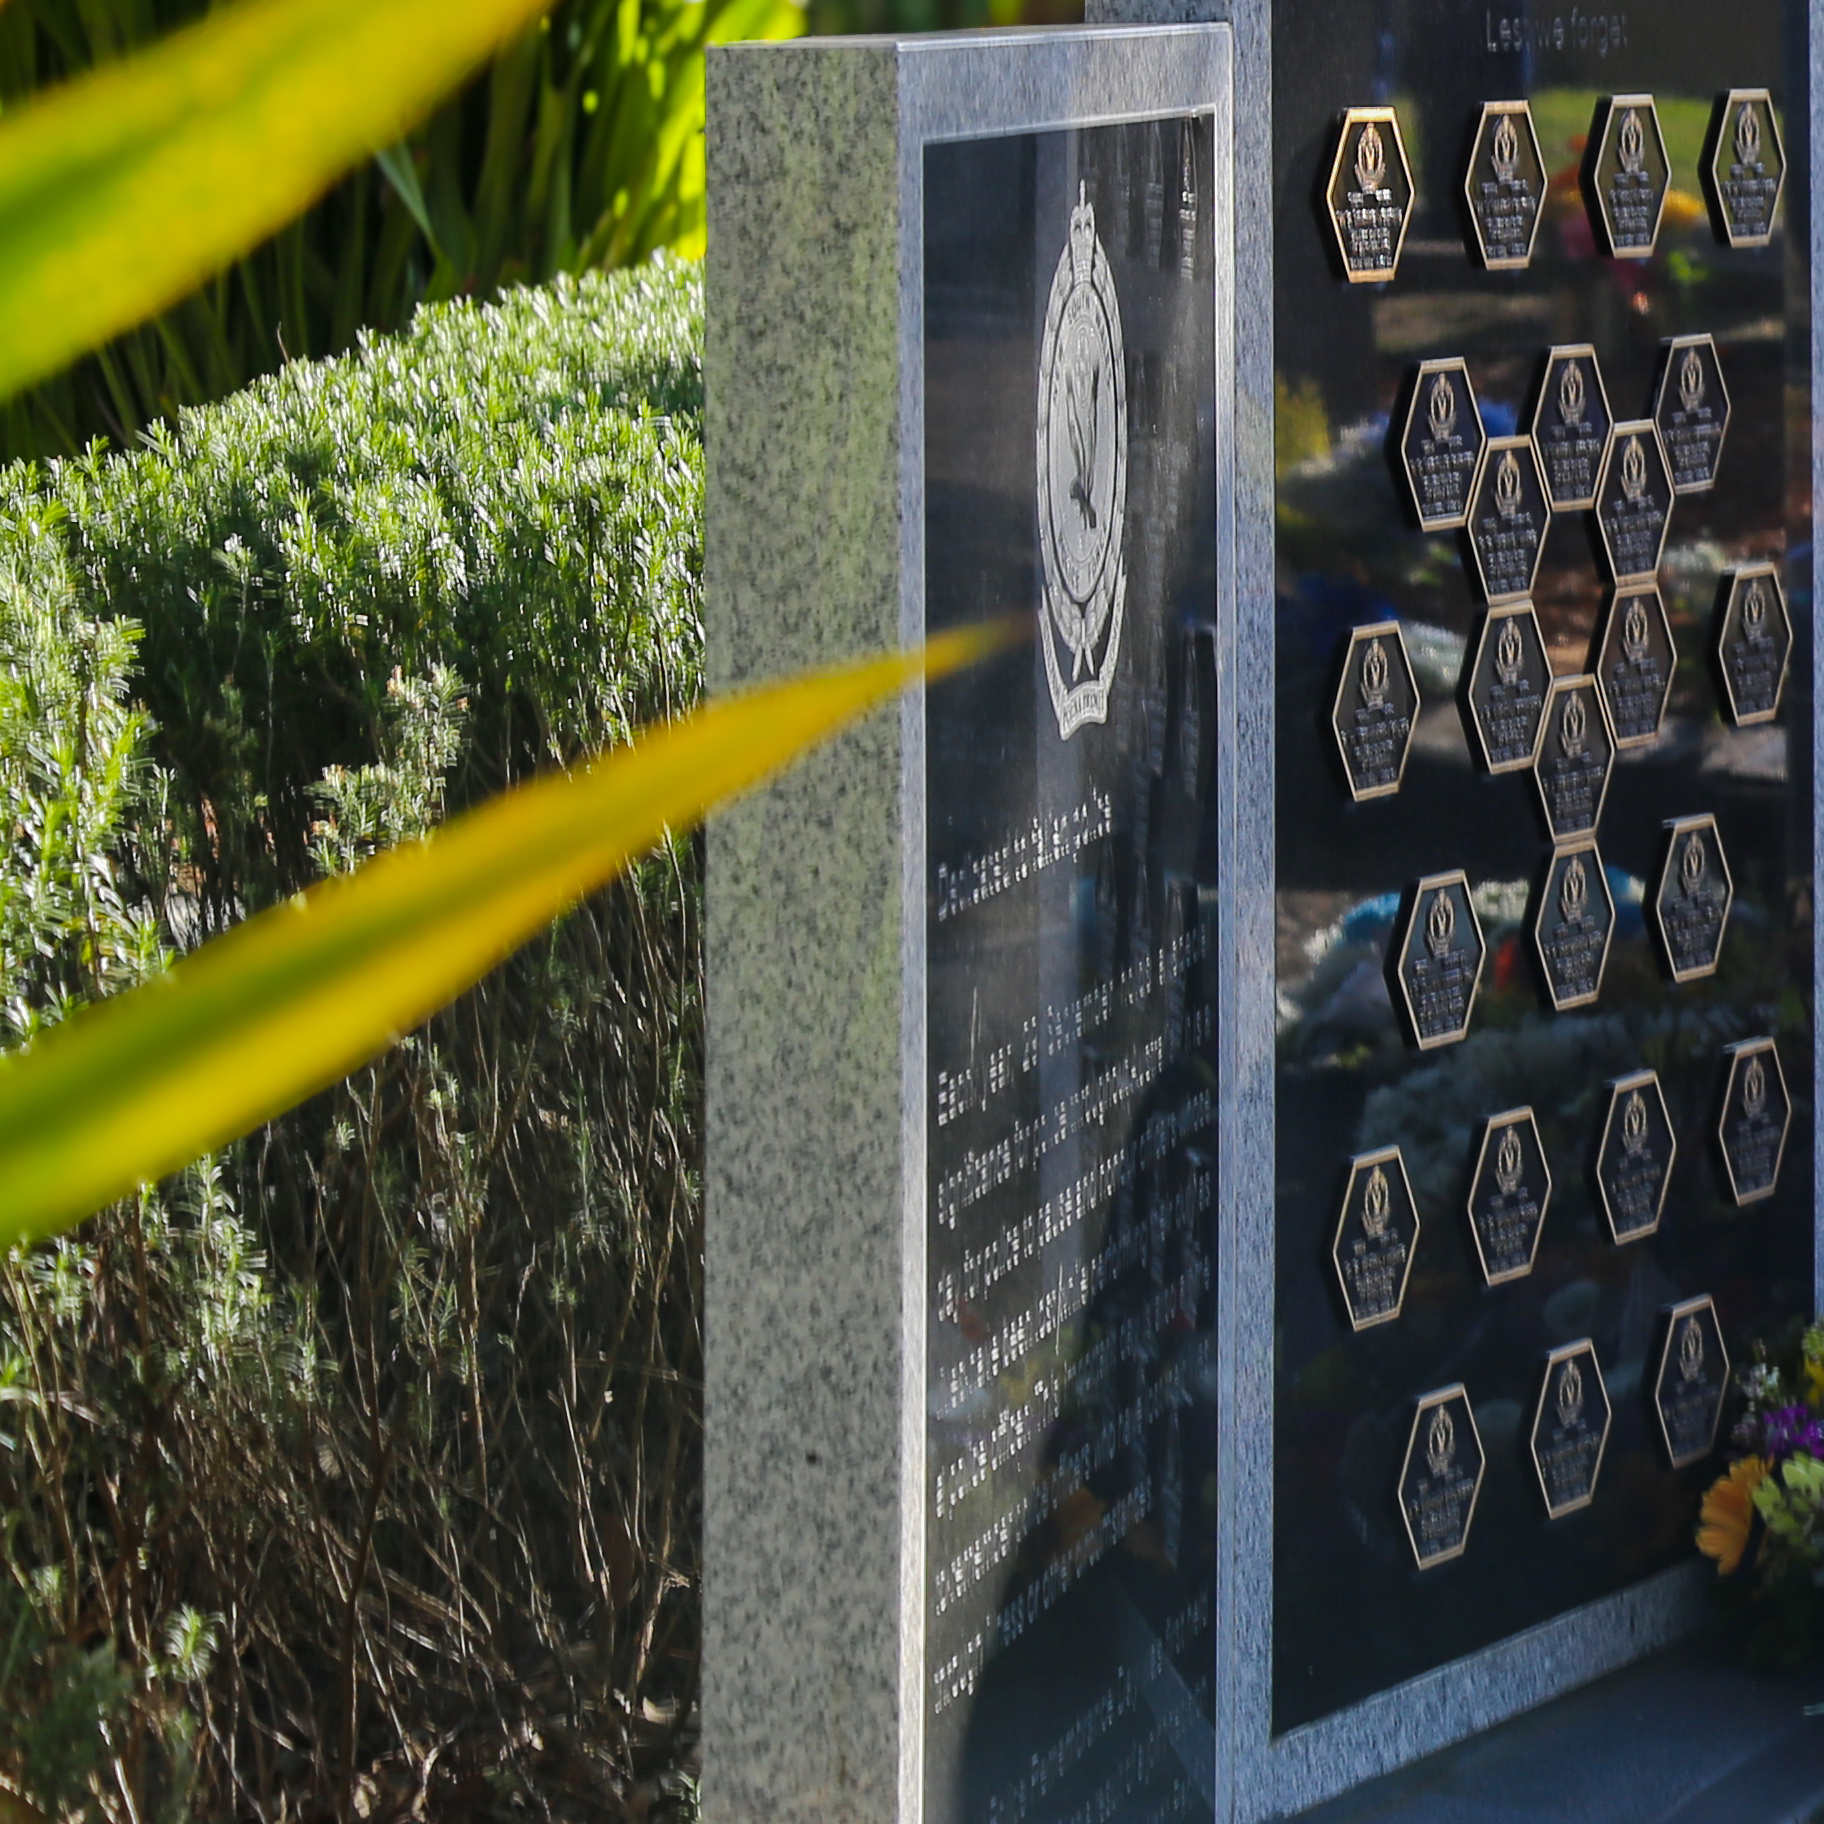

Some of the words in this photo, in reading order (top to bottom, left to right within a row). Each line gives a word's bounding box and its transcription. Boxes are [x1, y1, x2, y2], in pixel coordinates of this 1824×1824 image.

[938, 1054, 972, 1127] Each
[976, 1041, 1012, 1114] year
[1046, 977, 1113, 1059] September
[937, 1137, 1010, 1229] significance
[937, 1266, 957, 1325] day
[962, 1249, 979, 1305] for
[983, 1221, 1018, 1301] police
[1022, 1206, 1034, 1260] to
[1037, 1188, 1070, 1260] pause
[1074, 1158, 1095, 1222] and
[968, 1332, 998, 1394] have
[1001, 1306, 1031, 1368] been
[948, 1434, 985, 1521] police
[1034, 1369, 1059, 1435] This
[934, 1613, 982, 1714] through
[1026, 1573, 1038, 1625] or
[1042, 1541, 1071, 1609] other
[950, 1510, 1011, 1605] remember
